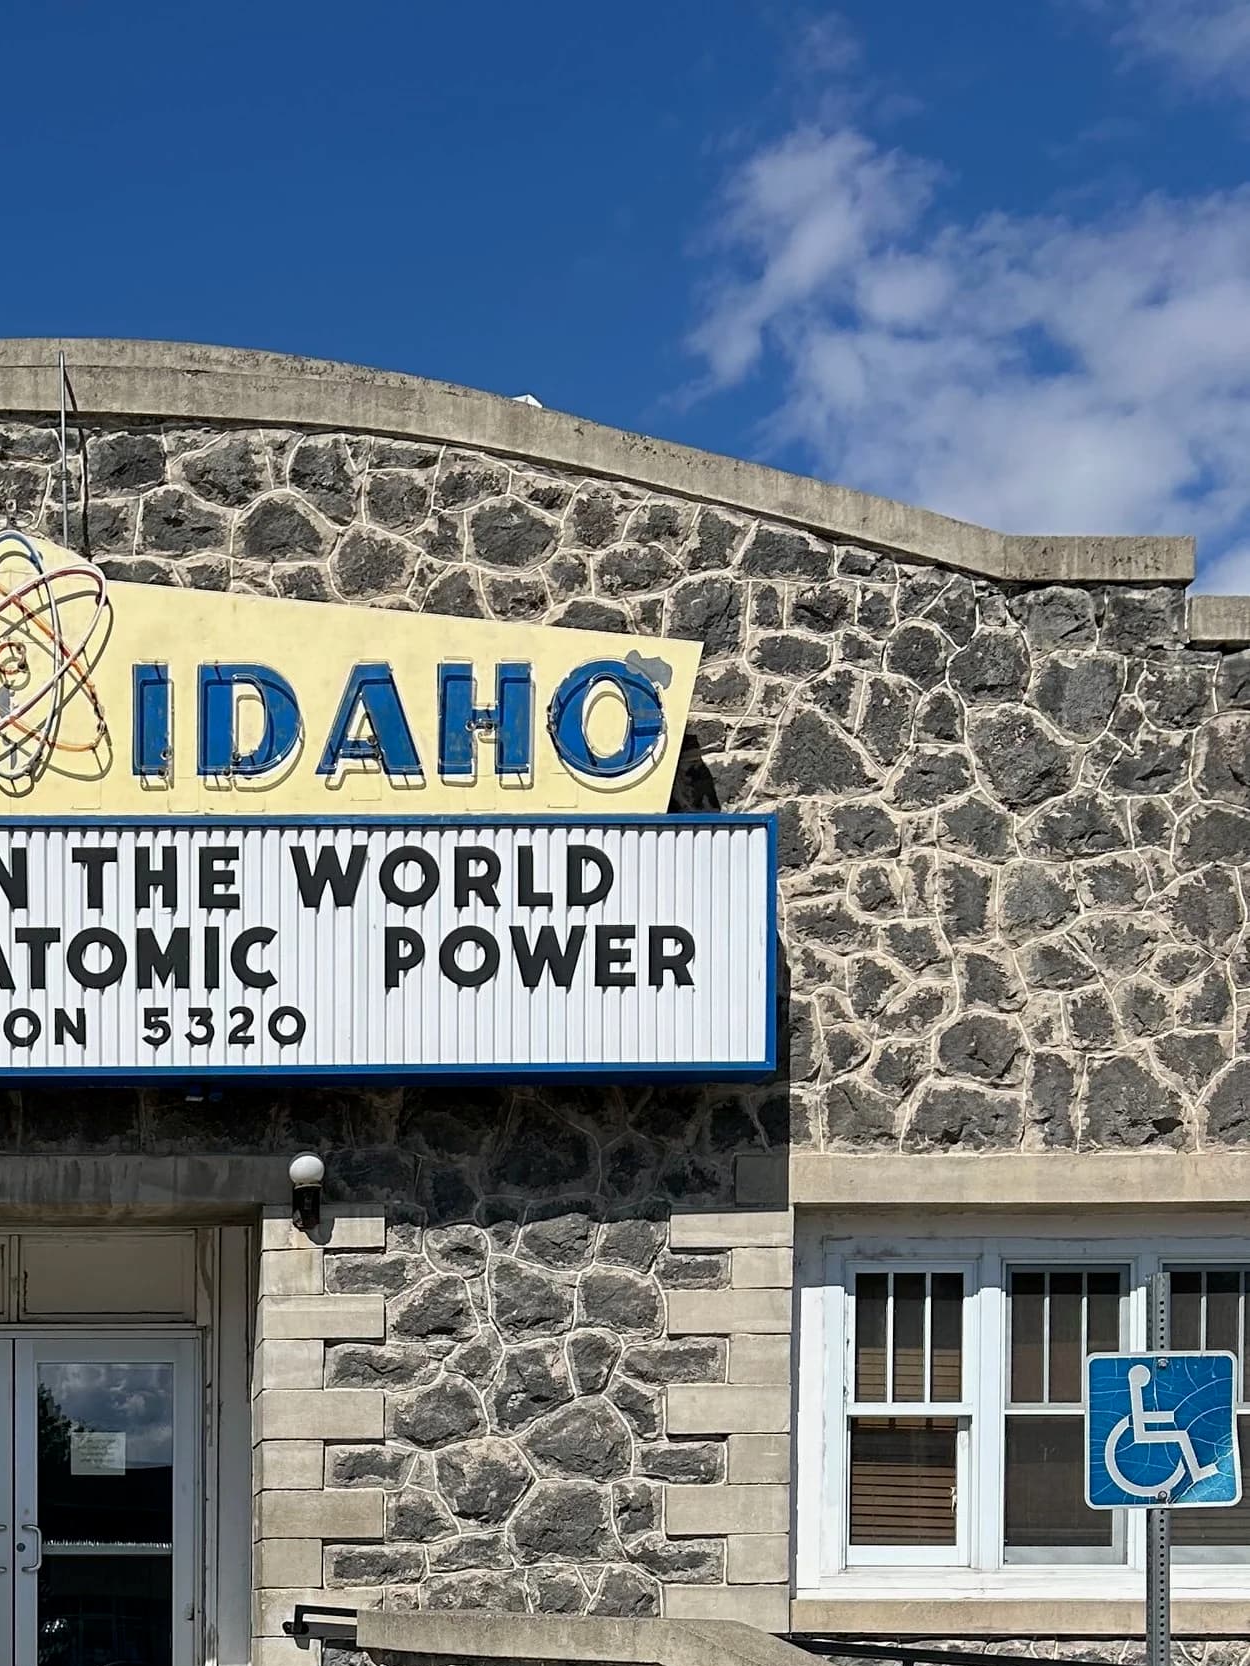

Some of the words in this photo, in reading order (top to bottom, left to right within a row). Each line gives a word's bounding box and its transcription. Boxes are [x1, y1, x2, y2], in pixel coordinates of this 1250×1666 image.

[130, 655, 668, 778] IDAHO
[71, 844, 240, 909] THE
[290, 844, 615, 909] WORLD
[384, 924, 696, 989] POWER
[143, 1005, 306, 1046] 5320
